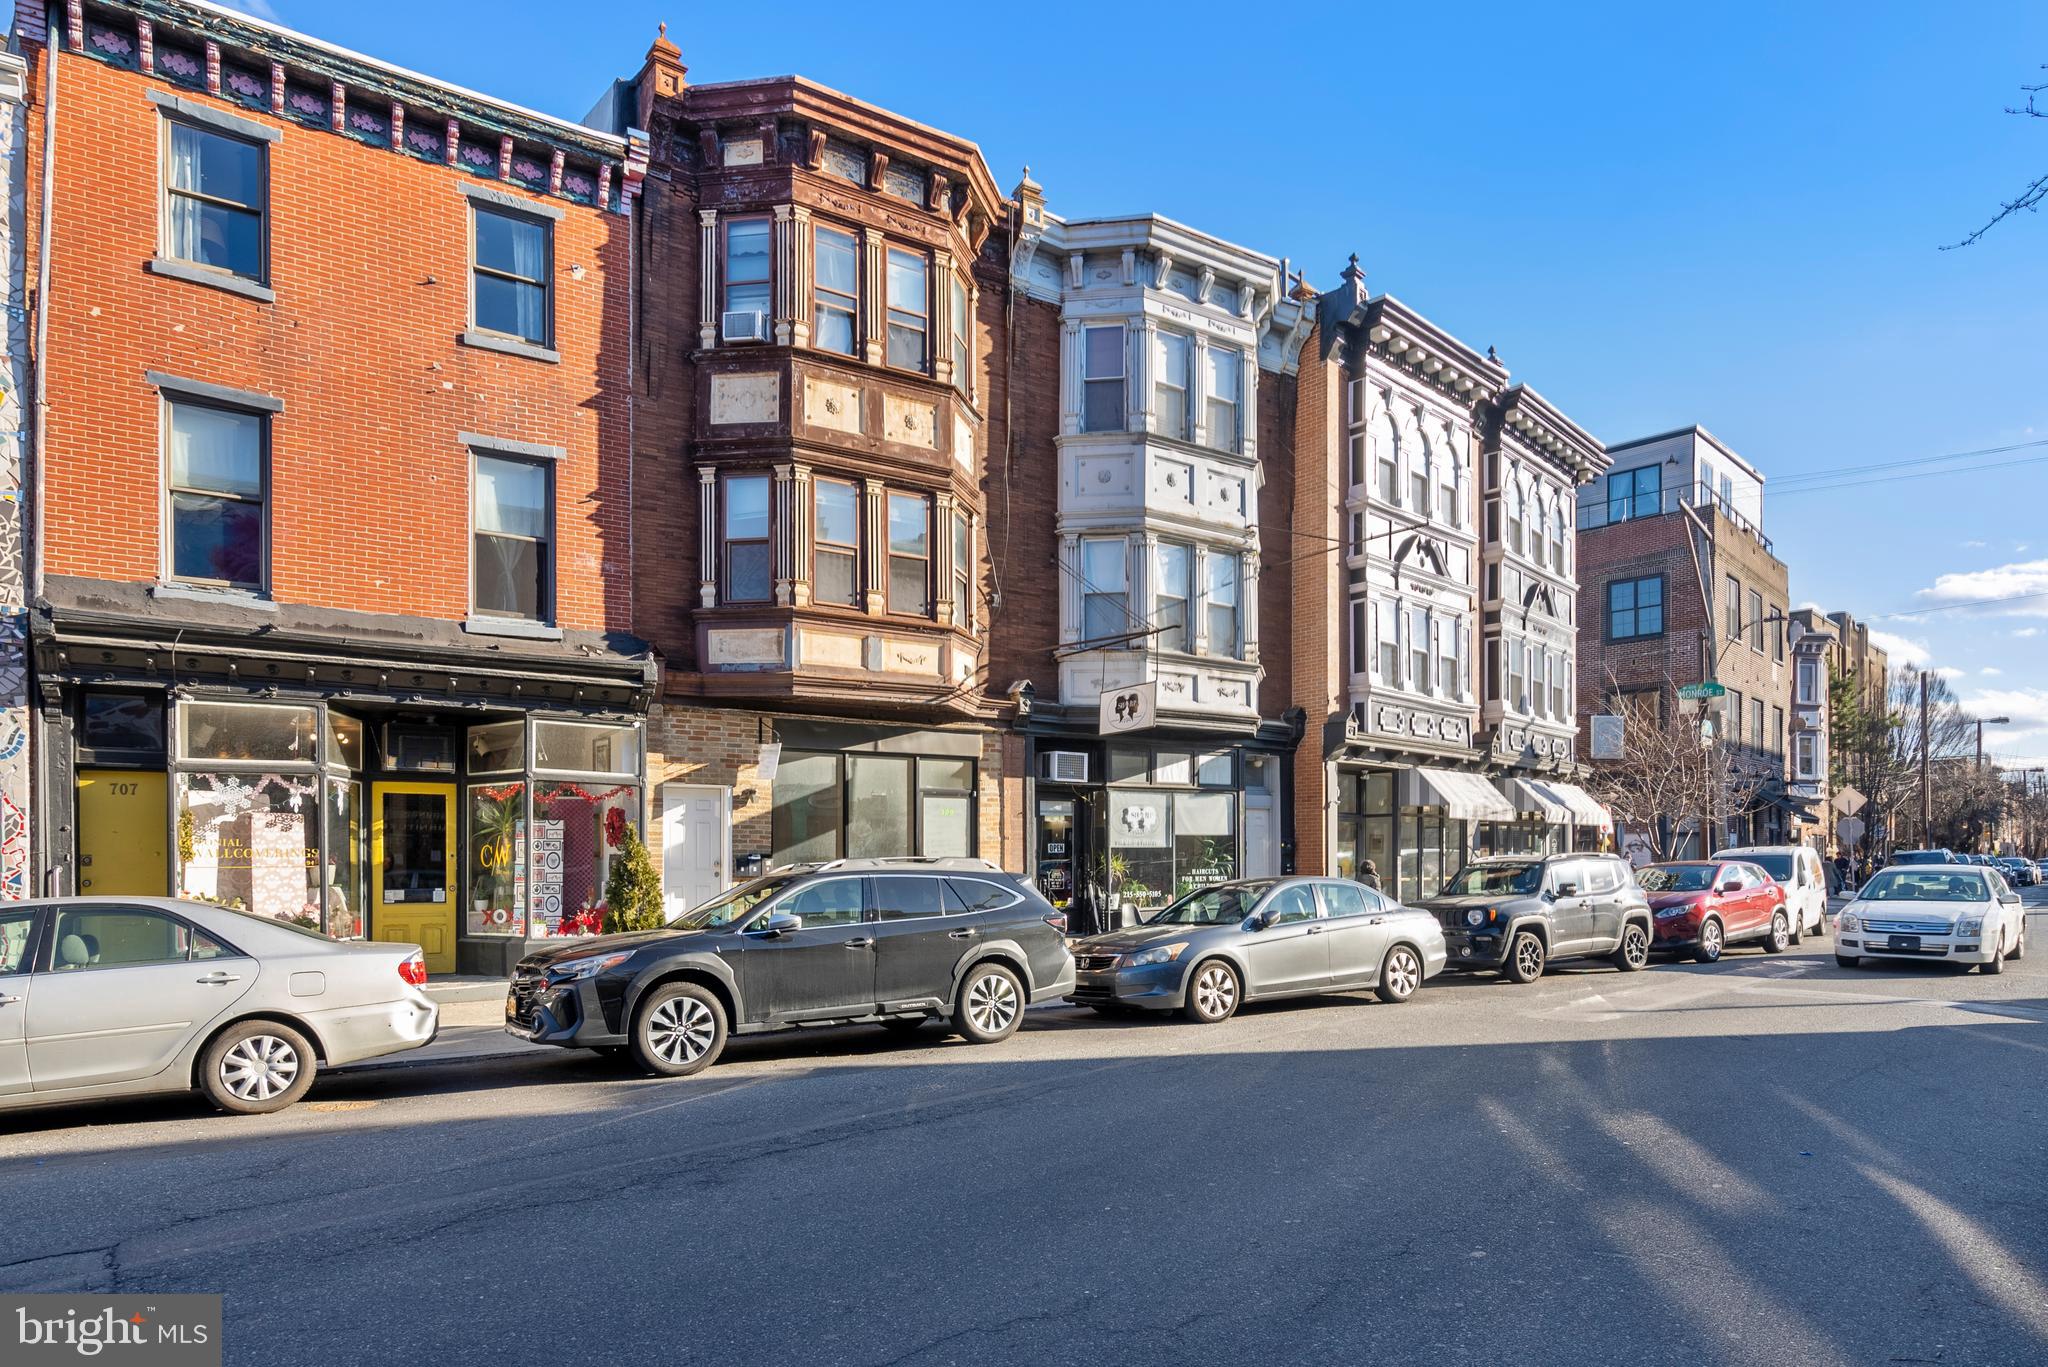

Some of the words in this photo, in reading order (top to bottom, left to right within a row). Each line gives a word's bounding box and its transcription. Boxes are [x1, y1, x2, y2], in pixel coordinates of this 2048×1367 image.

[1680, 688, 1713, 698] MONROE
[109, 783, 138, 796] 707
[1049, 844, 1064, 852] OPEN
